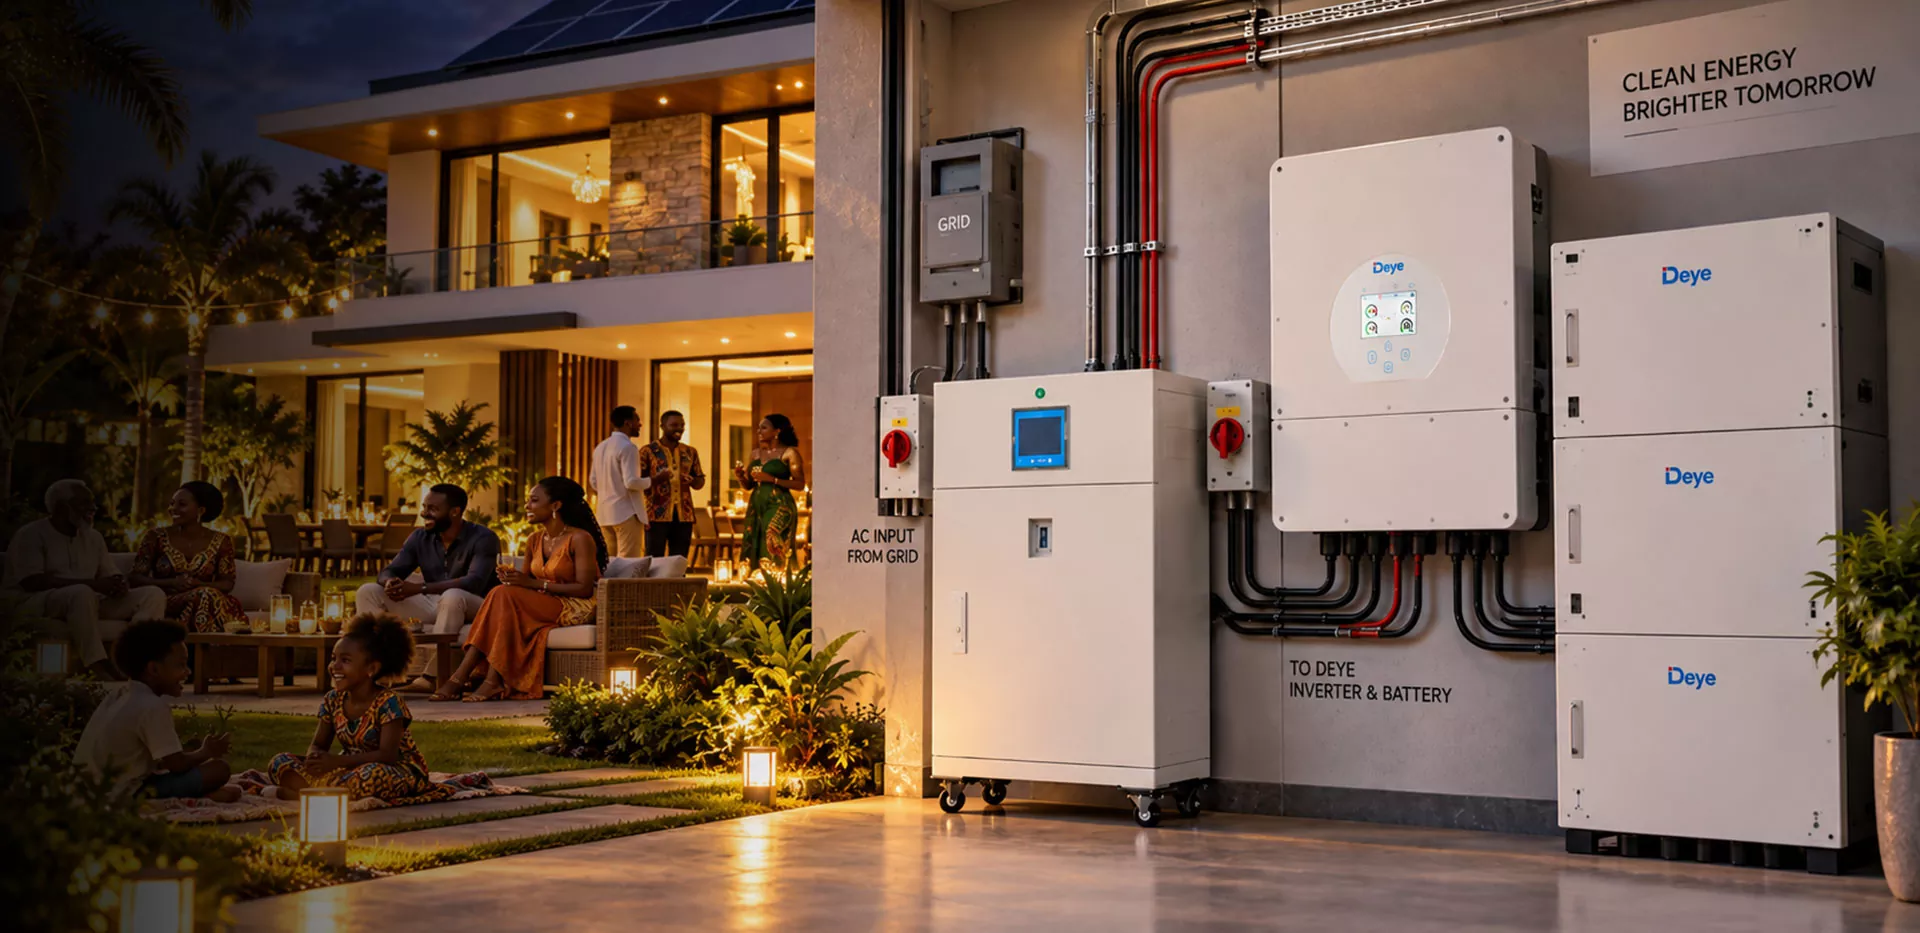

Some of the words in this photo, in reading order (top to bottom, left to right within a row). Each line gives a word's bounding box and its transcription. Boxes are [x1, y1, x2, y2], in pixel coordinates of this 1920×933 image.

[1622, 63, 1697, 93] CLEAN
[1704, 46, 1798, 82] ENERGY
[1623, 89, 1728, 122] BRIGHTER
[1734, 66, 1877, 107] TOMORROW
[938, 214, 971, 232] GRID
[1372, 261, 1405, 275] Deye
[1661, 265, 1712, 287] Deye
[1665, 466, 1715, 489] Deye
[851, 528, 870, 544] AC
[873, 528, 915, 544] INPUT
[847, 549, 884, 564] FROM
[886, 549, 919, 564] GRID
[1289, 660, 1311, 677] TO
[1315, 661, 1356, 678] DEYE
[1667, 666, 1717, 690] Deye
[1289, 683, 1363, 701] INVERTER
[1366, 685, 1379, 702] &
[1382, 685, 1452, 704] BATTERY
